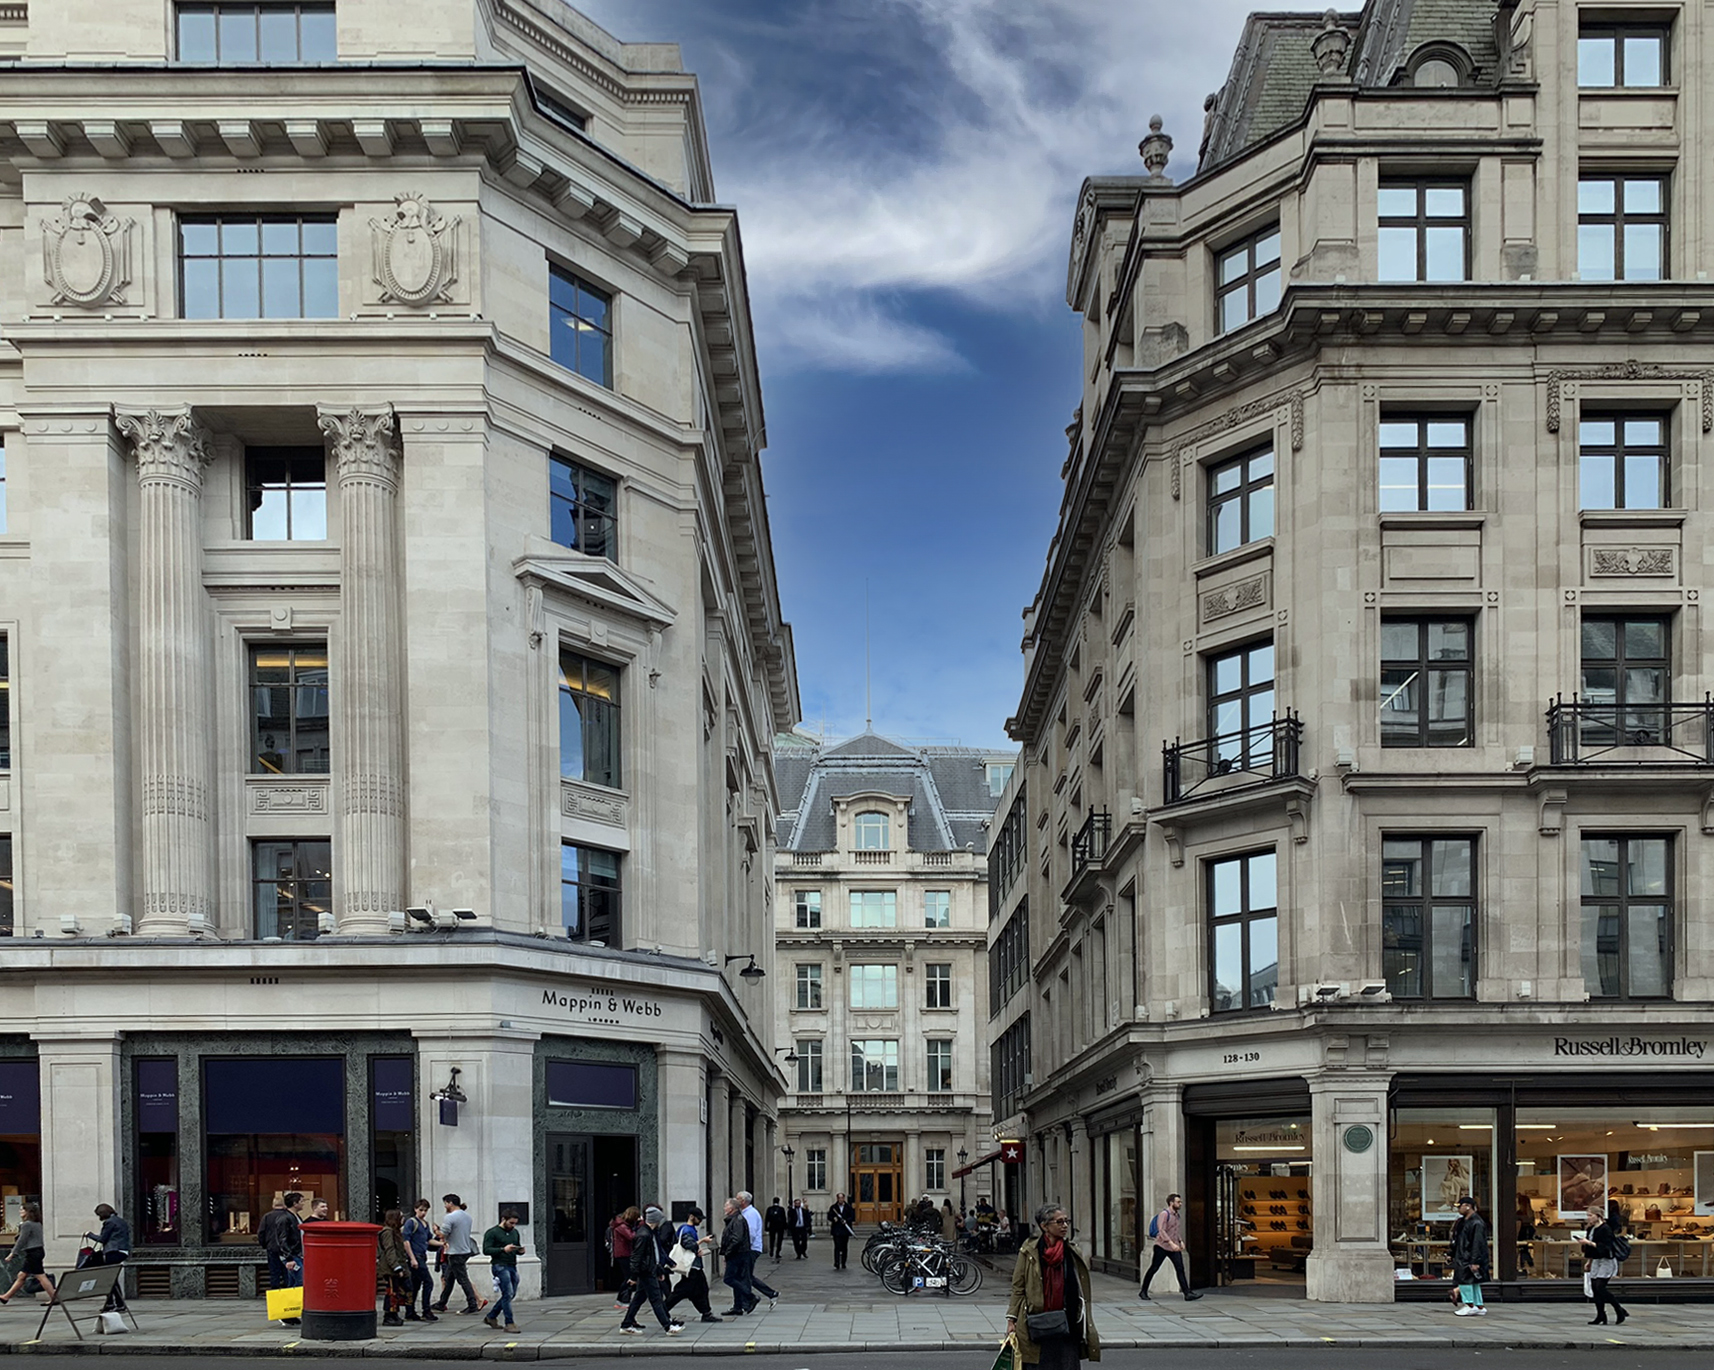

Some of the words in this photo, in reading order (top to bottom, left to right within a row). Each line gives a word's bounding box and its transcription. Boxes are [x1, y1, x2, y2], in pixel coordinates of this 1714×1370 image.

[542, 990, 601, 1013] Mappin
[608, 998, 617, 1012] &
[622, 999, 661, 1016] Webb
